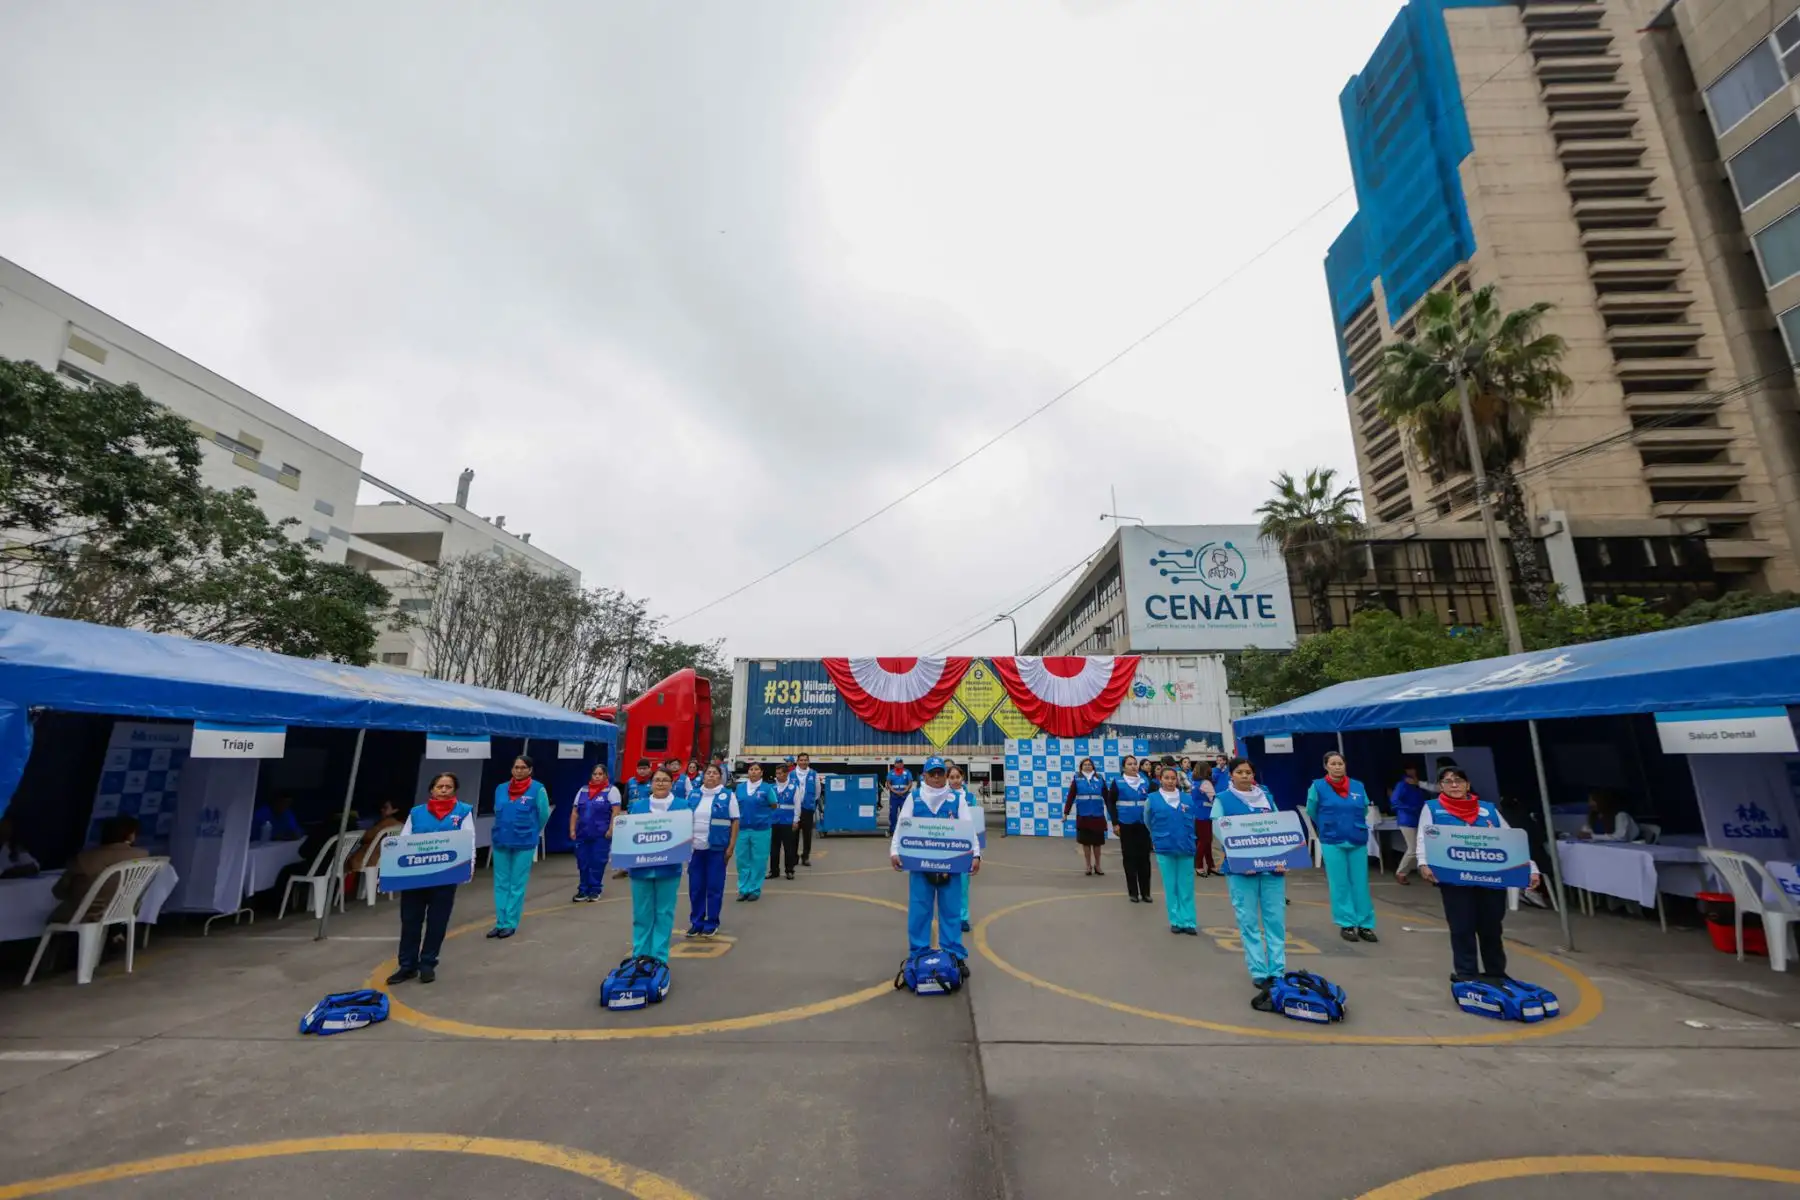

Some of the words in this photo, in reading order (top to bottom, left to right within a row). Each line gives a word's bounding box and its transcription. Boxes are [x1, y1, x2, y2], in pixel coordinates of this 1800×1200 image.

[1145, 594, 1276, 620] CENATE
[764, 680, 802, 704] #33
[803, 681, 837, 691] Millones
[803, 692, 836, 704] Unidos
[764, 706, 785, 716] Ante
[785, 706, 792, 716] el
[793, 706, 833, 717] Fenómeno
[784, 717, 792, 727] El
[793, 717, 813, 727] Niño
[1688, 731, 1719, 740] Salud
[1720, 730, 1756, 739] Dental
[222, 738, 254, 750] Triaje
[1723, 823, 1789, 838] EsSalud
[637, 832, 668, 843] Puno
[902, 838, 923, 847] Costa,
[924, 839, 946, 847] Sierra
[1227, 833, 1300, 848] Lambayeque
[1451, 833, 1481, 841] Hospital
[406, 852, 450, 865] Tarma
[1450, 847, 1505, 861] Iquitos
[619, 991, 633, 1001] 24
